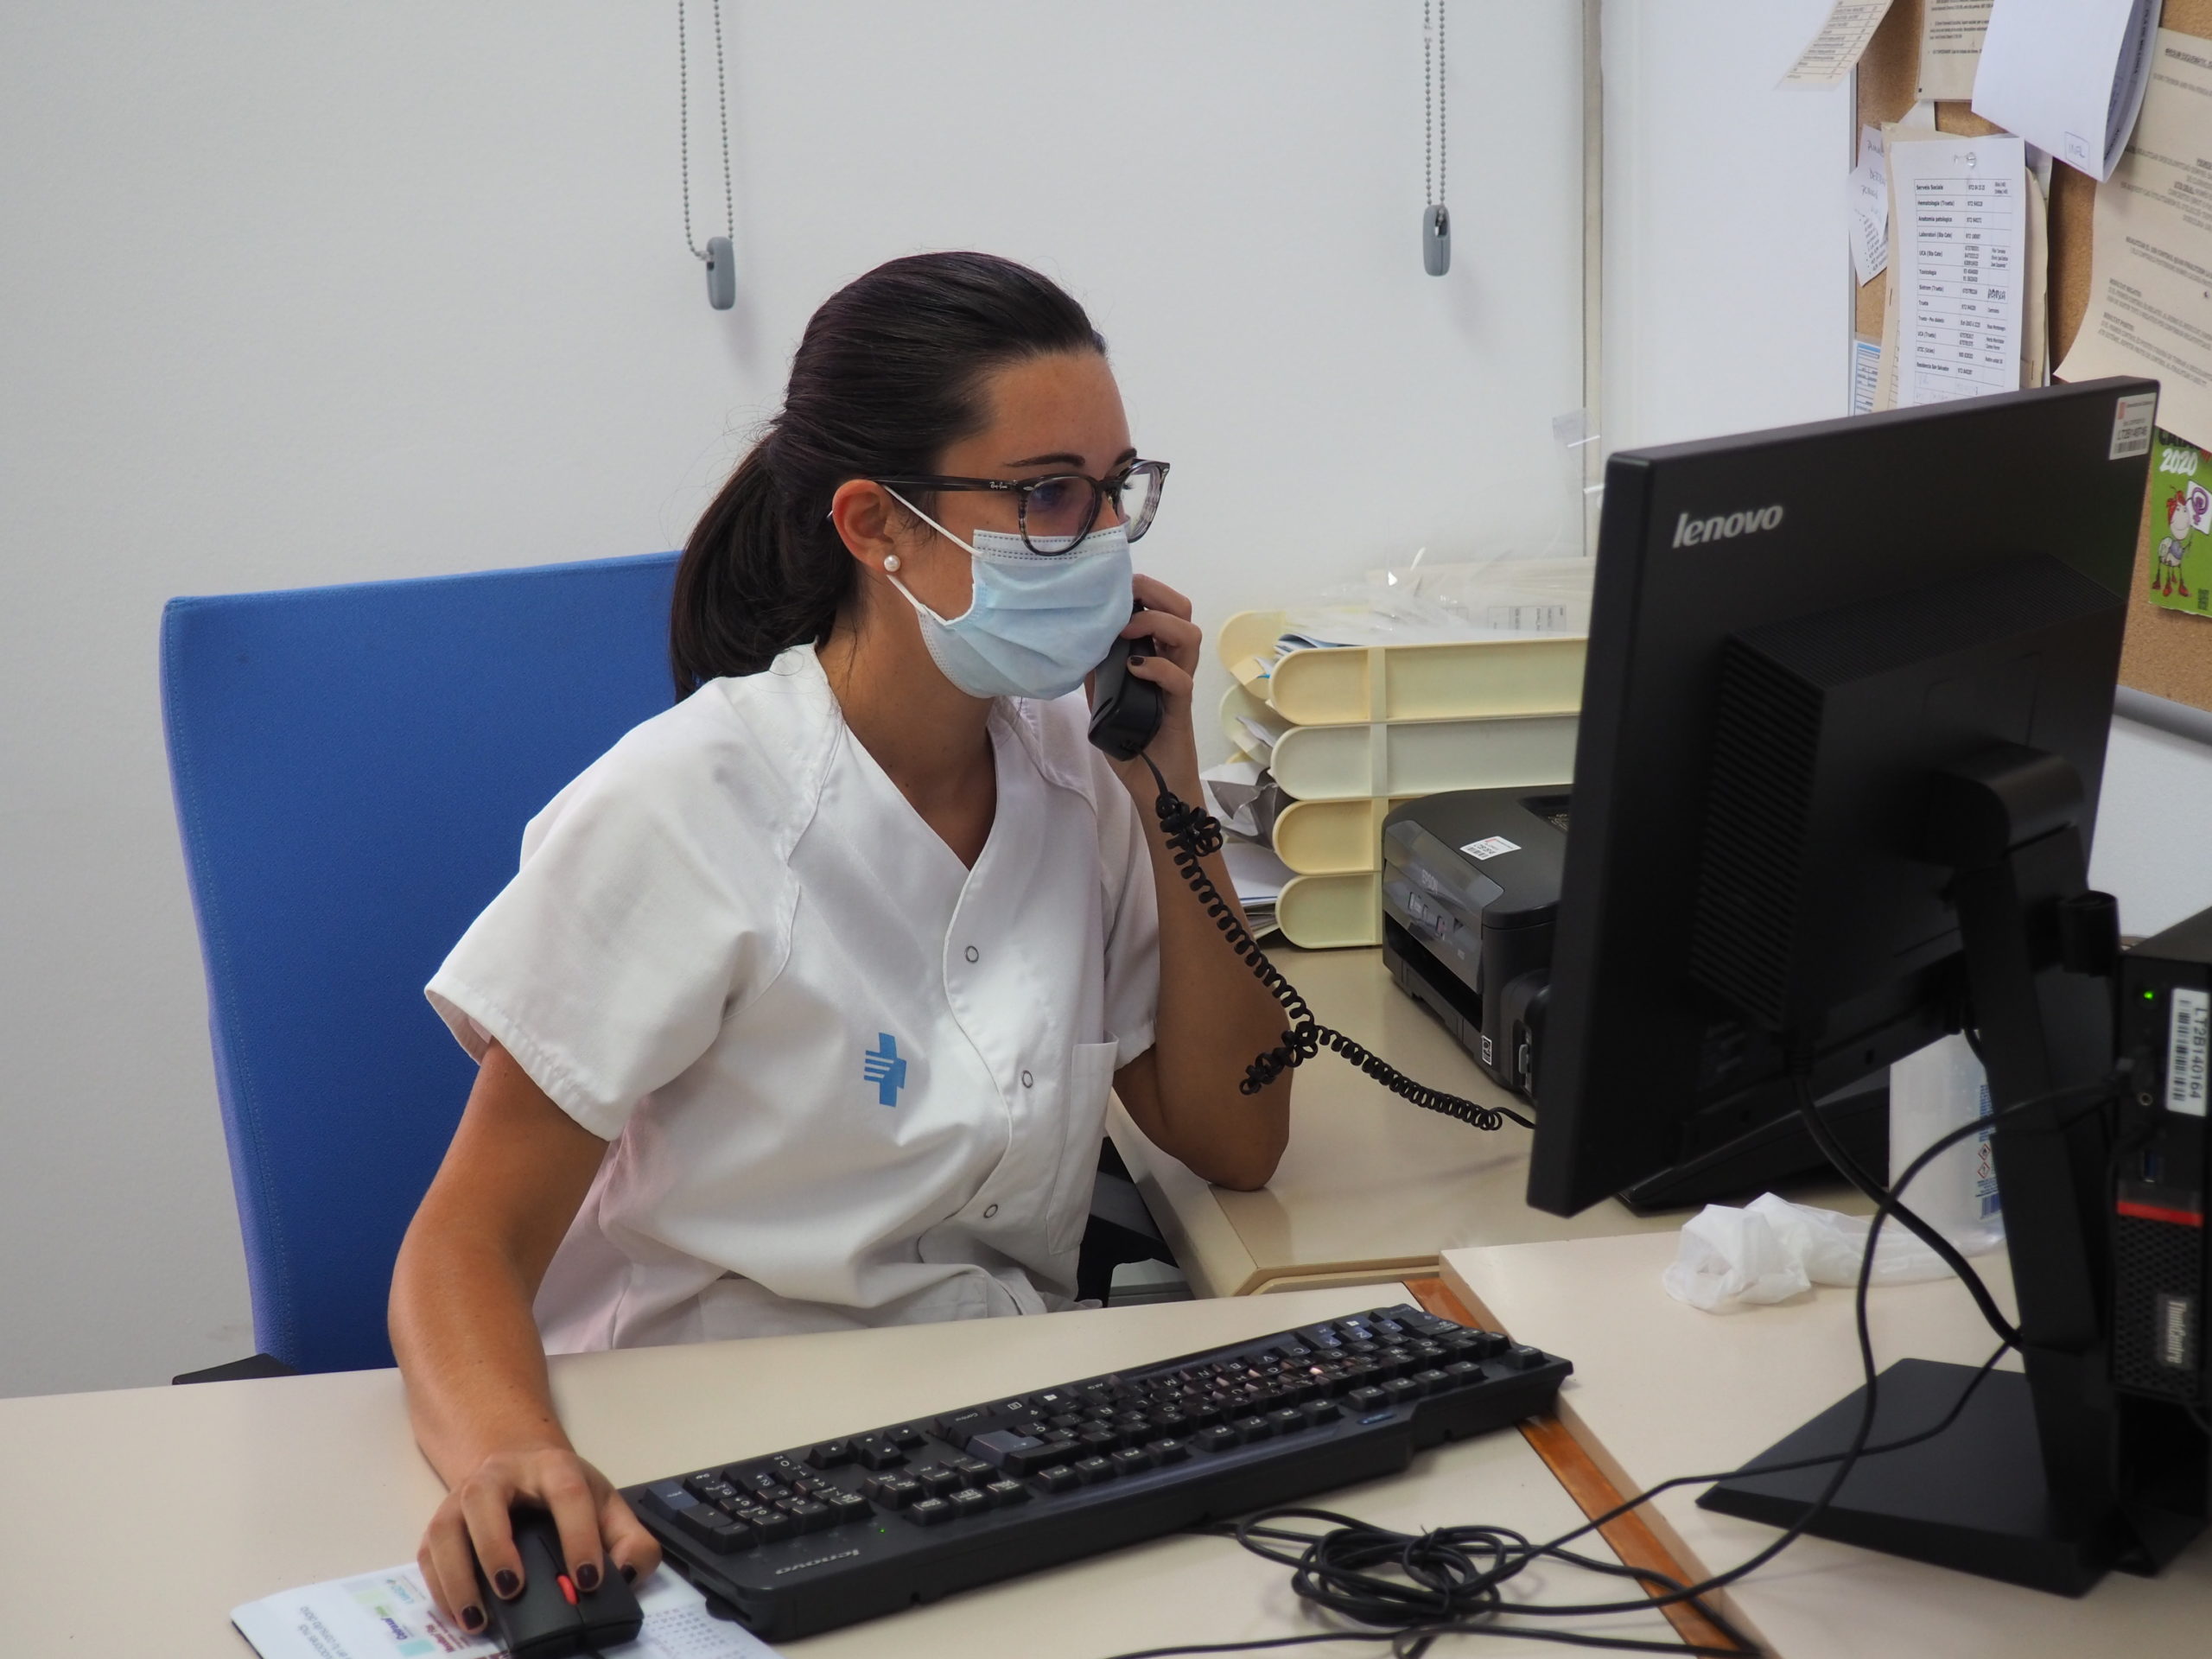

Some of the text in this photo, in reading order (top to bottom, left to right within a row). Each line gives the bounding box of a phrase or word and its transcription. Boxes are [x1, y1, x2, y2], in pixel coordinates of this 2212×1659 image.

[2159, 448, 2198, 476] 2020
[1672, 505, 1783, 549] lenovo
[2190, 1007, 2209, 1100] LT2B140164
